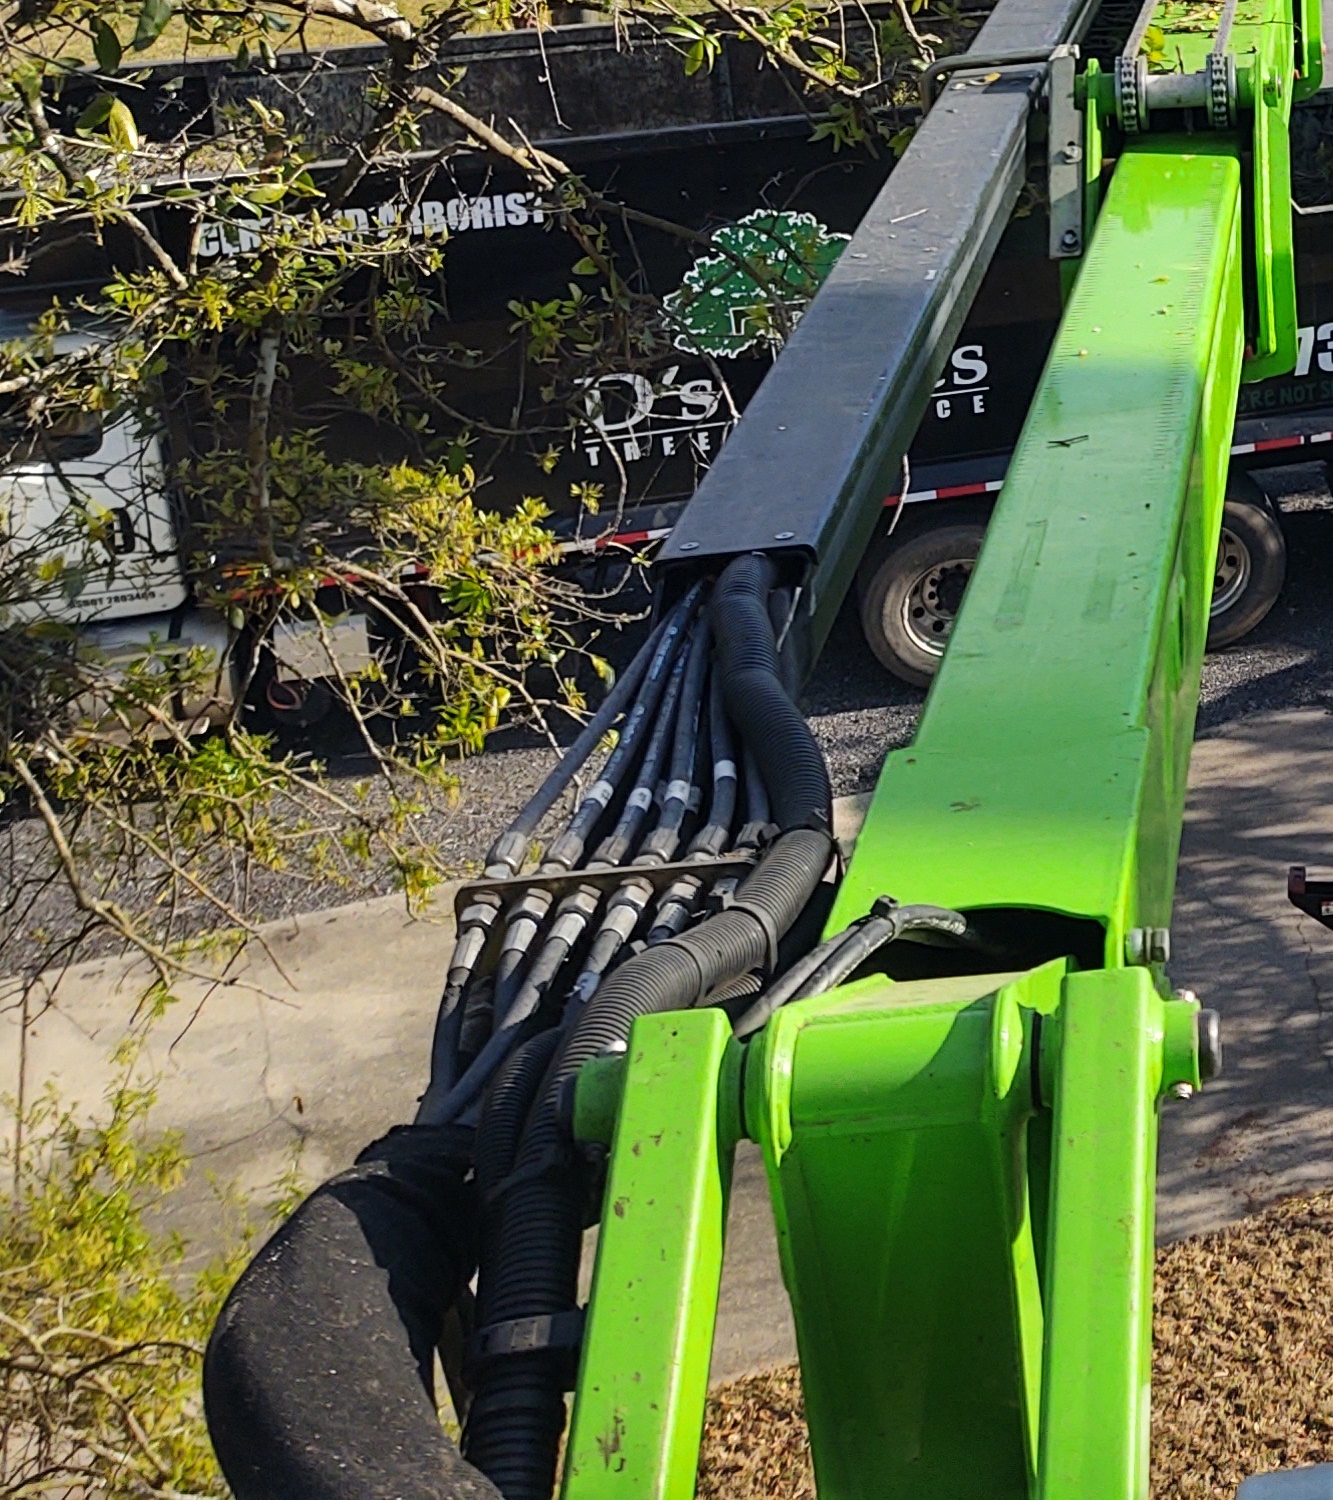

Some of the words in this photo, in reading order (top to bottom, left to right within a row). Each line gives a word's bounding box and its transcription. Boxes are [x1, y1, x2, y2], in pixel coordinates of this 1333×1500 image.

[378, 191, 545, 240] ARBORIST
[573, 364, 721, 432] D's
[1279, 382, 1318, 406] NOT
[585, 431, 711, 467] TREE
